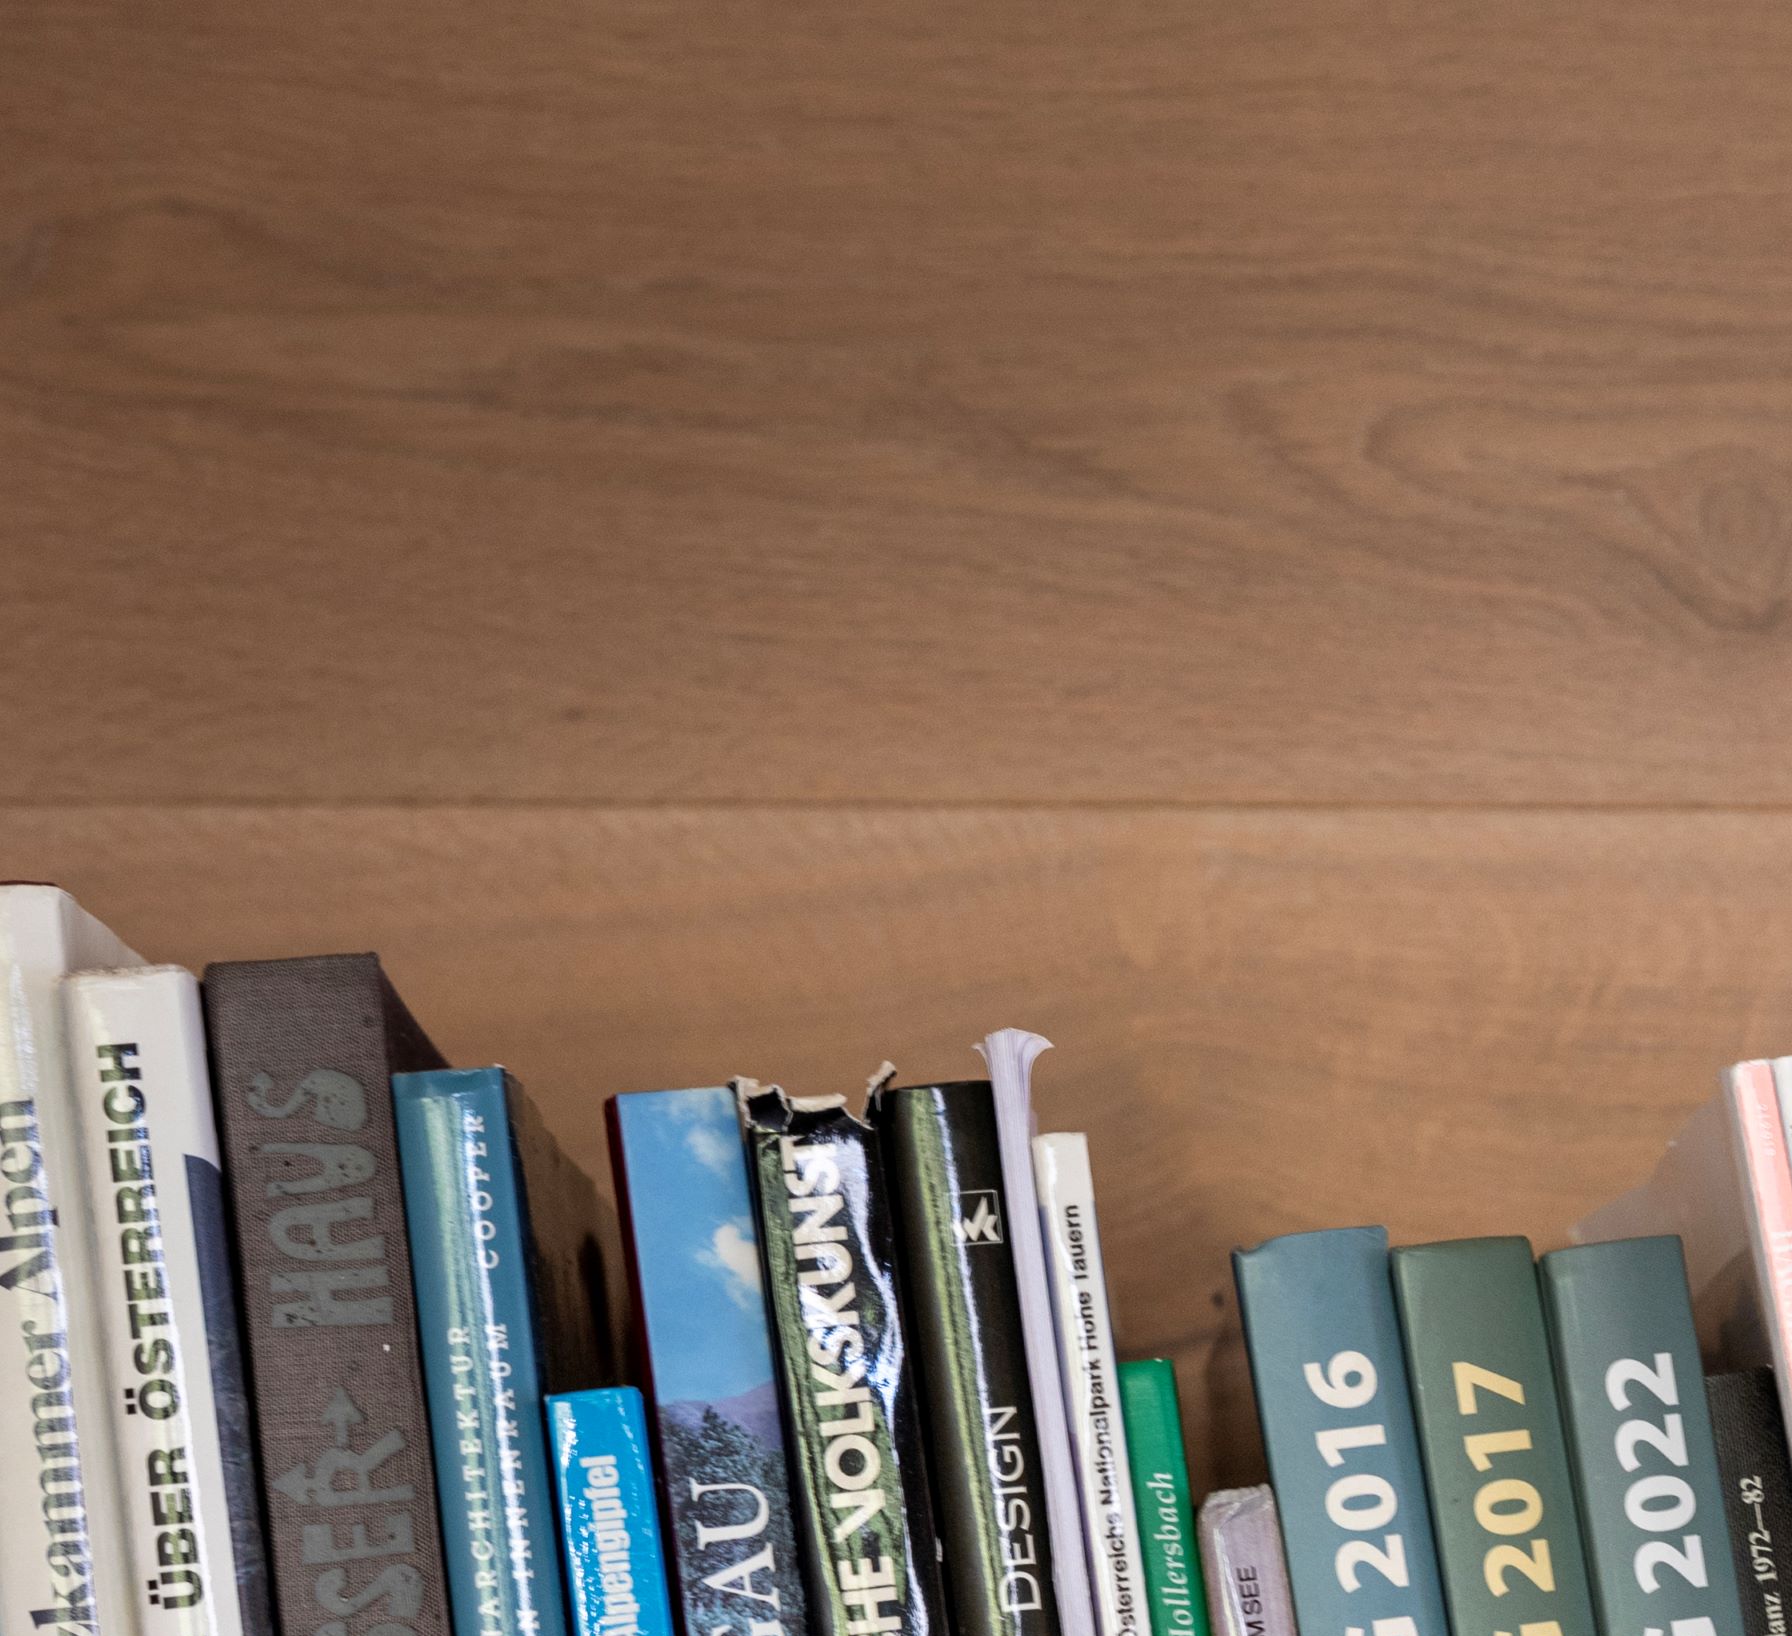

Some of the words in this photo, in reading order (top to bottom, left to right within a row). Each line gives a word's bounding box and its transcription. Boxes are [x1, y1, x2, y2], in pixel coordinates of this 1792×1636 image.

[0, 1099, 60, 1301] Alpen
[95, 1041, 178, 1419] ÖSTERREICH
[246, 1066, 393, 1328] HAUS
[464, 1111, 500, 1269] COOPER
[1063, 1204, 1091, 1281] Tauern
[778, 1133, 887, 1539] VOLKSKUNST
[1073, 1287, 1099, 1350] Hohe
[147, 1446, 202, 1608] ÜBER
[483, 1320, 535, 1579] INNENRAUM
[983, 1404, 1044, 1611] DESIGN
[1081, 1359, 1118, 1504] Nationalpark
[1302, 1348, 1411, 1591] 2016
[1452, 1359, 1556, 1596] 2017
[1603, 1351, 1708, 1590] 2022
[1236, 1563, 1264, 1617] SEE
